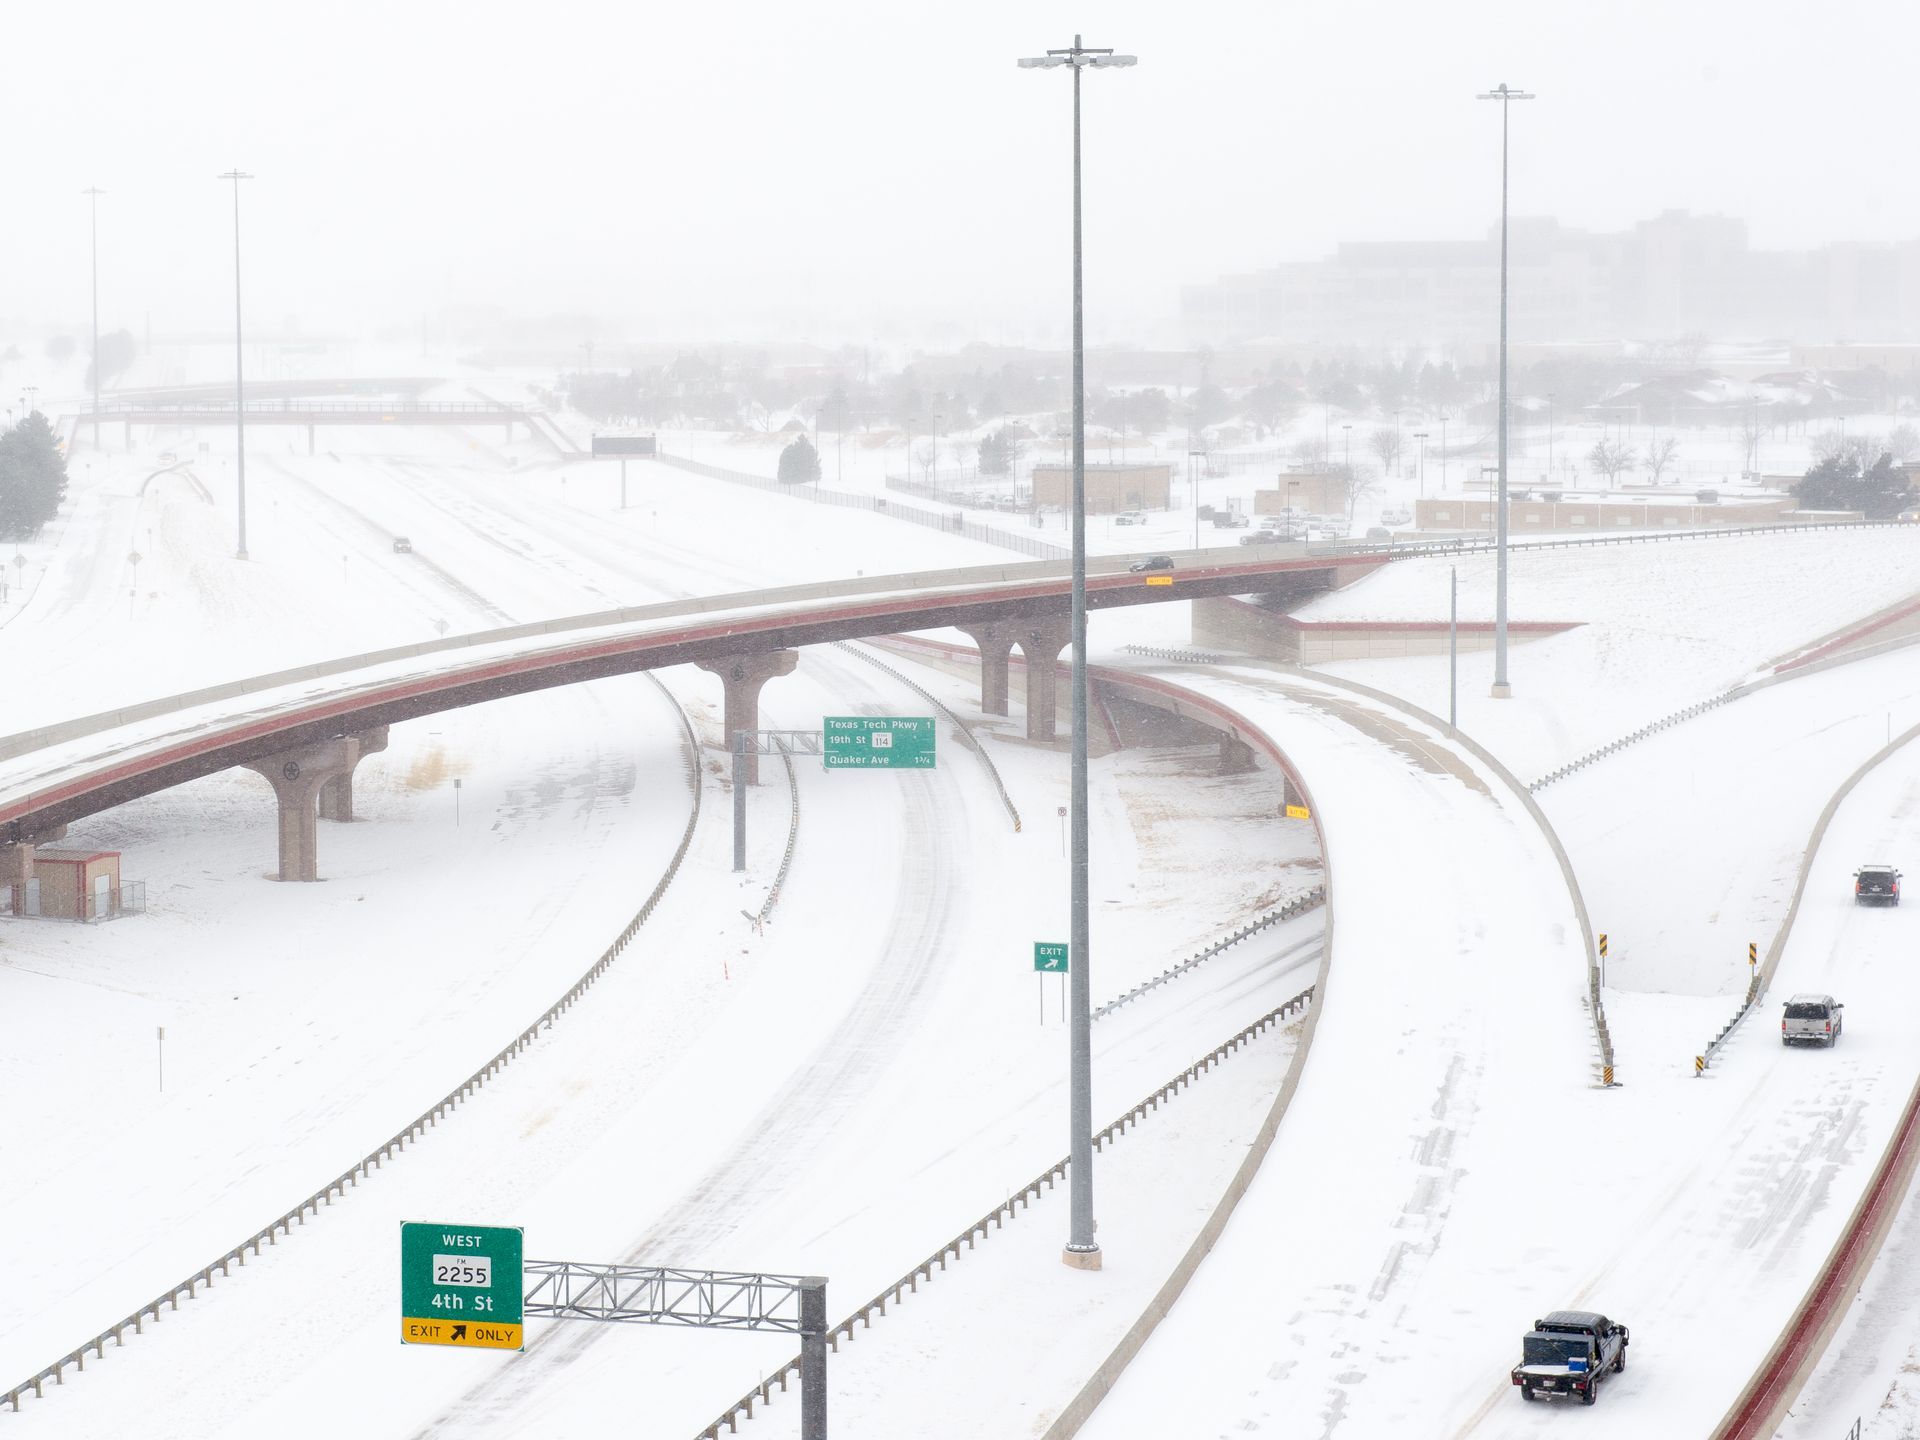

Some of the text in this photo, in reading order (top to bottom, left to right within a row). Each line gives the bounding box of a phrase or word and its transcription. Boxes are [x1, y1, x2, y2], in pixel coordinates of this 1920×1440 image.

[892, 721, 918, 730] Pkwy
[875, 738, 888, 746] 114
[830, 756, 866, 764] Quaker
[1041, 948, 1062, 956] EXIT
[442, 1235, 482, 1247] WEST
[438, 1266, 486, 1284] 2255
[432, 1294, 494, 1311] 4th St
[410, 1325, 514, 1342] EXIT ONLY
